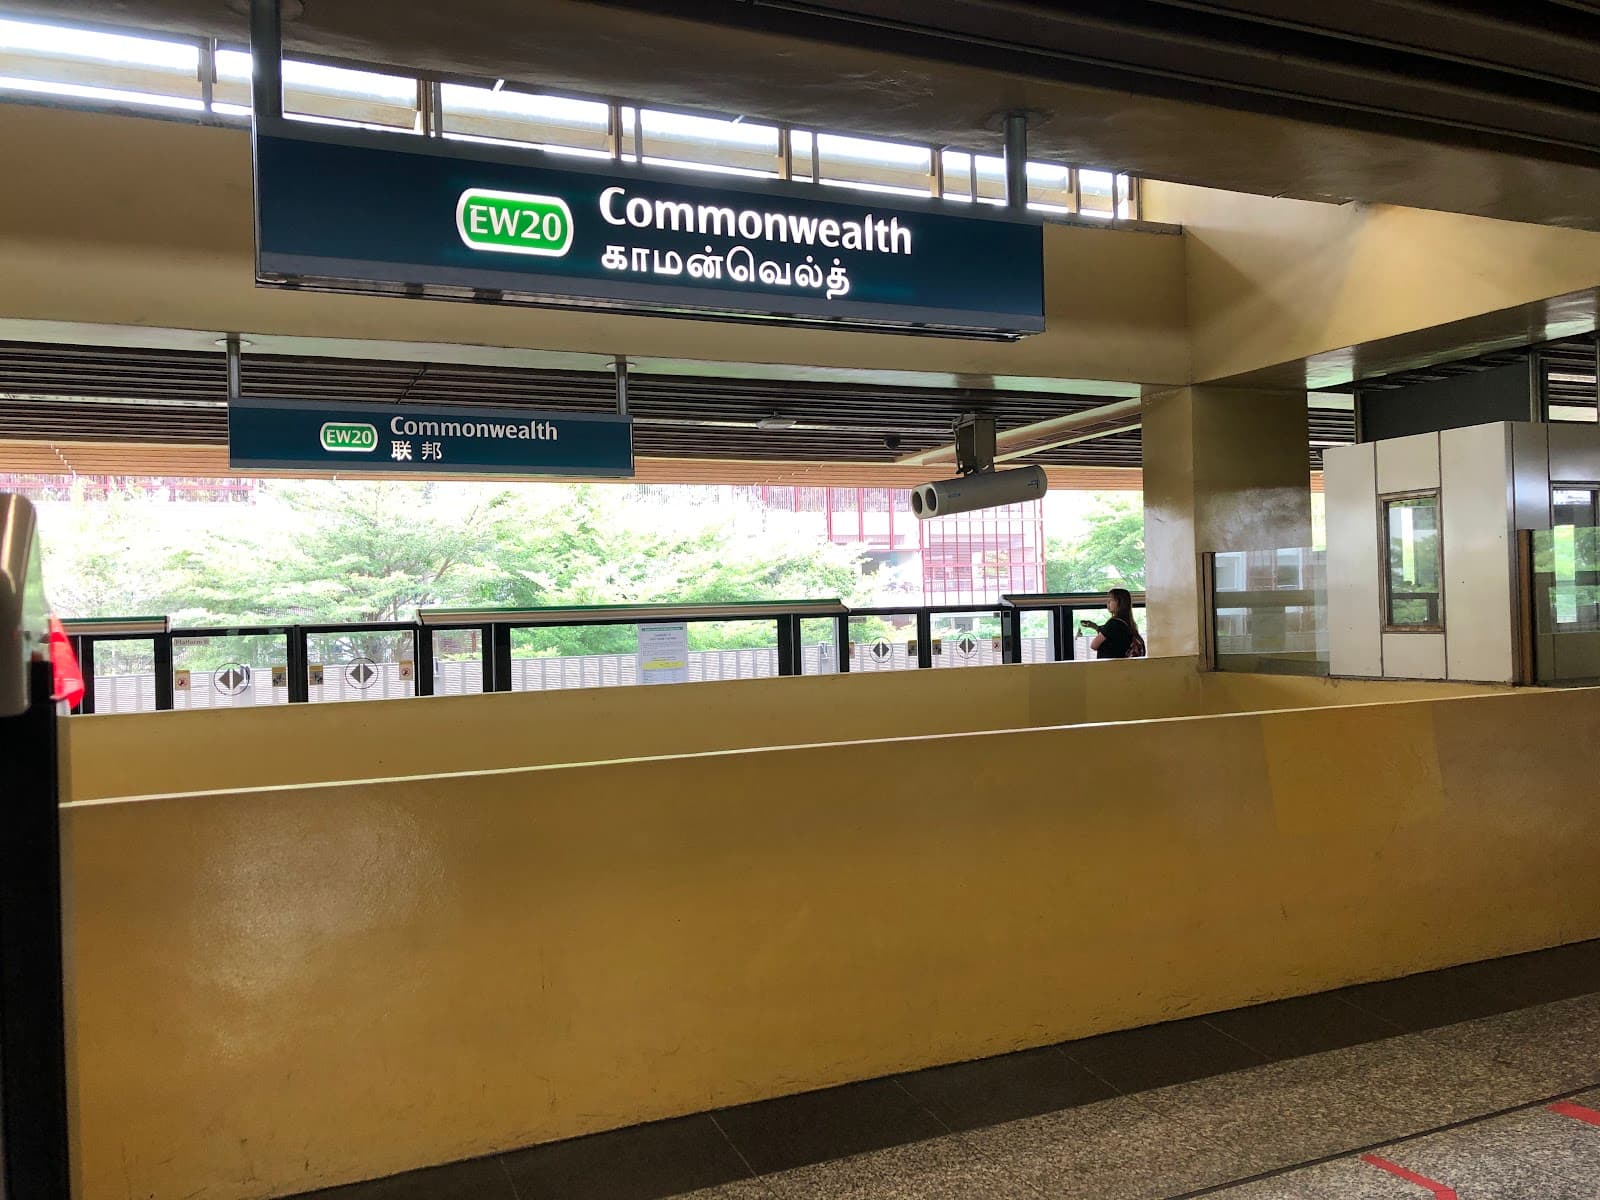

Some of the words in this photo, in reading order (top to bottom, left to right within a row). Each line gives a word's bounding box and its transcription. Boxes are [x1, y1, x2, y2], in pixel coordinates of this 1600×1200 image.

[469, 204, 562, 243] EW20
[599, 186, 913, 256] Commonwealth
[601, 244, 851, 300] காமன்வெல்த்
[326, 429, 372, 445] EW20
[390, 416, 558, 441] Commonwealth
